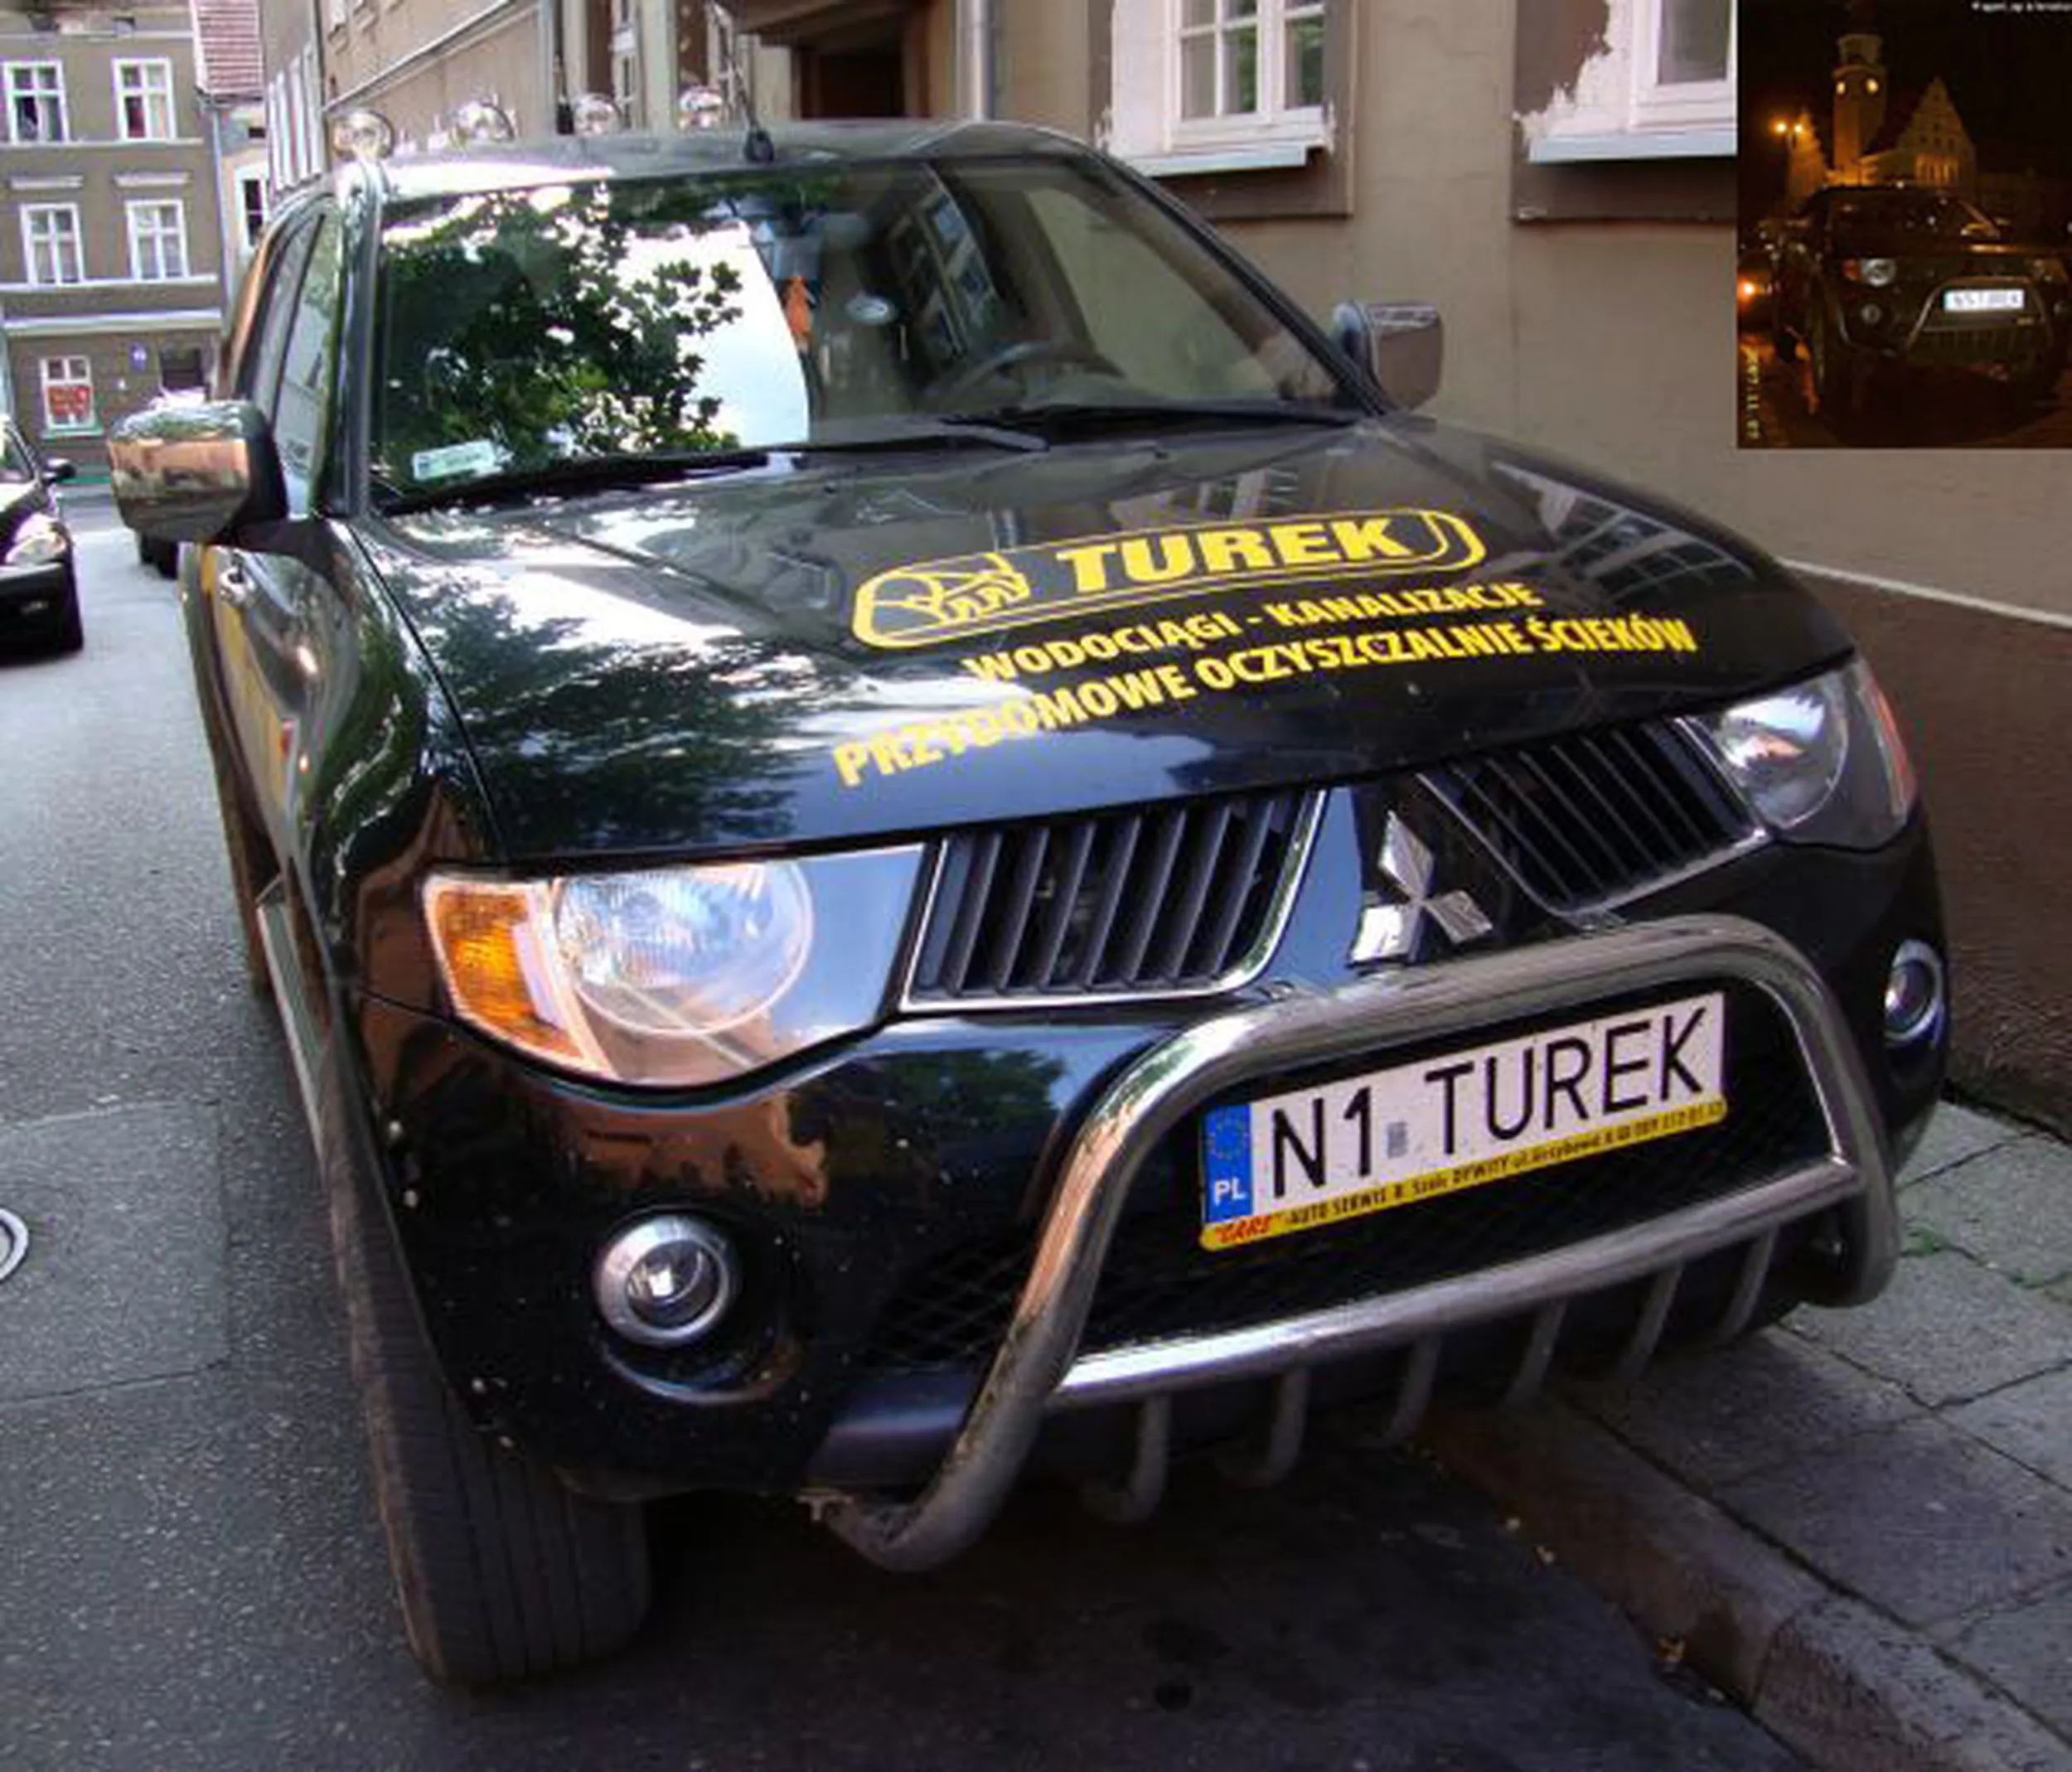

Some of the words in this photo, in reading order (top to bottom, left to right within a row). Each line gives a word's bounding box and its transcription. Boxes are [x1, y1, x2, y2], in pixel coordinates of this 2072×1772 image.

[1056, 517, 1414, 593] TUREK
[961, 612, 1242, 681] WODOCIĄGI
[1264, 582, 1546, 627] KANALIZACJE
[833, 665, 1198, 788] PRZYDOMOWE
[1194, 620, 1536, 689] OCZYSZCZALNIE
[1527, 612, 1699, 653] ŚCIEKÓW
[1272, 1087, 1372, 1198] N1
[1424, 1007, 1707, 1155] TUREK
[1213, 1177, 1247, 1206] PL
